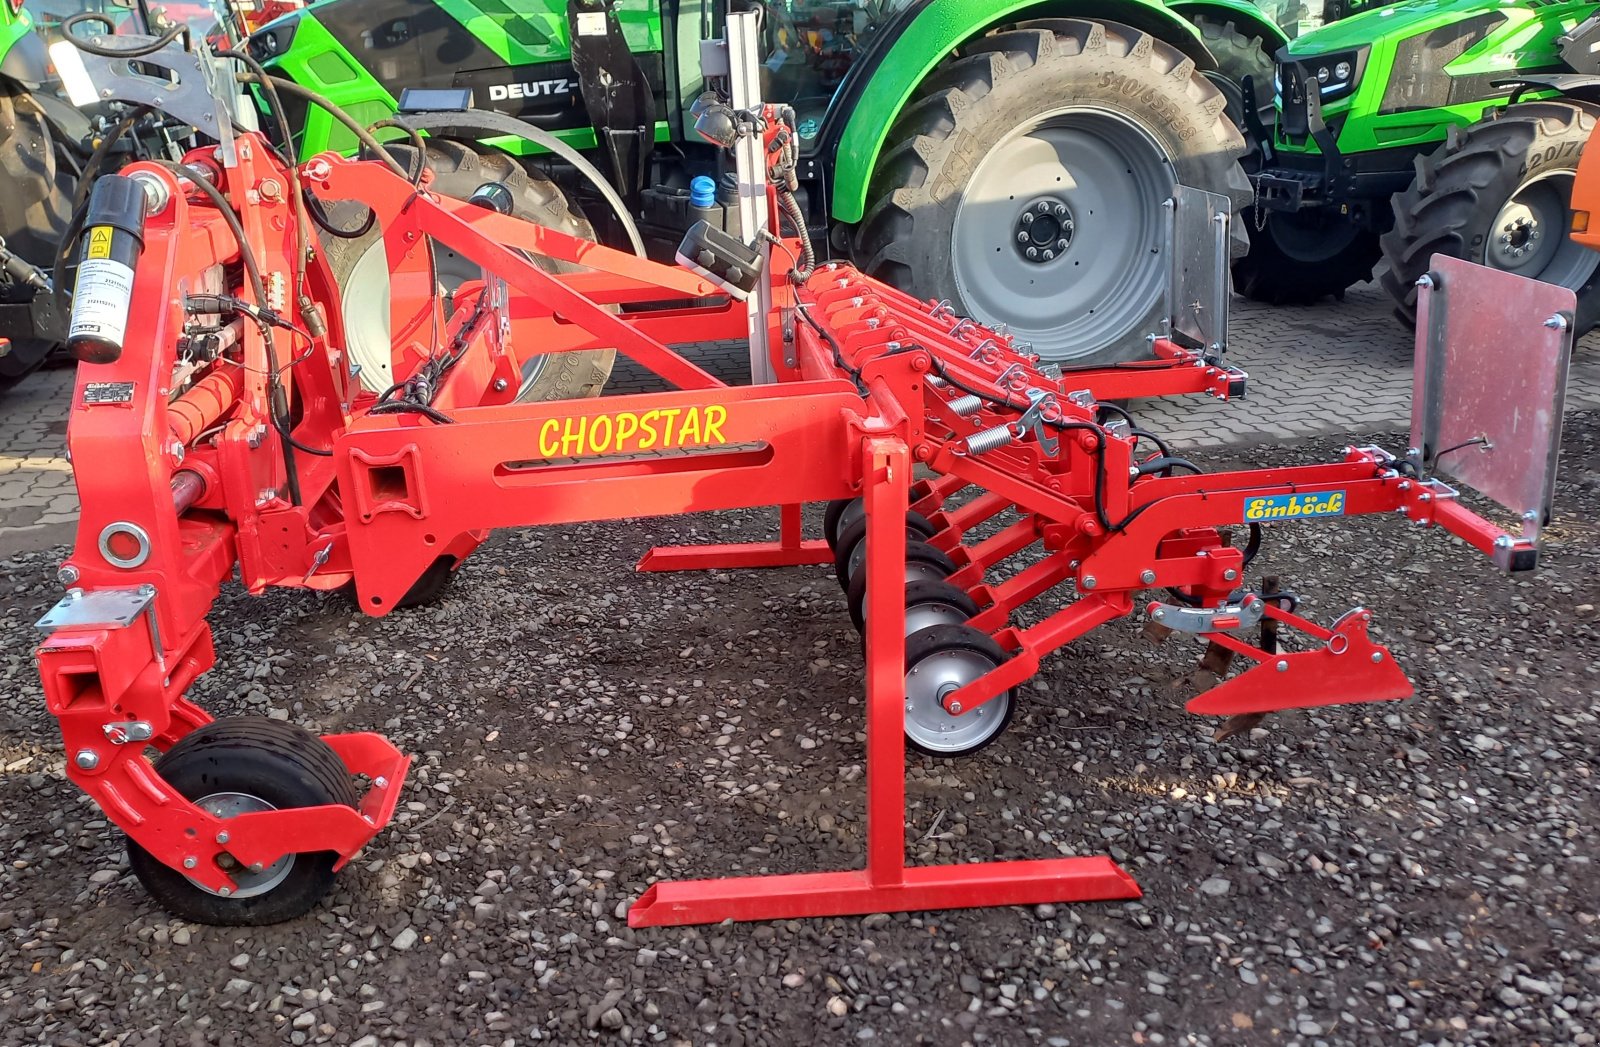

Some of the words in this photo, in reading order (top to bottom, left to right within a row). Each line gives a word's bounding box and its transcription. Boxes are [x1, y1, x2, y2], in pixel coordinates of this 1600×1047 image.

[488, 78, 579, 101] DEUTZ-
[1096, 70, 1197, 141] 540/65R38
[538, 404, 728, 457] CHOPSTAR
[1246, 493, 1343, 519] Einböck
